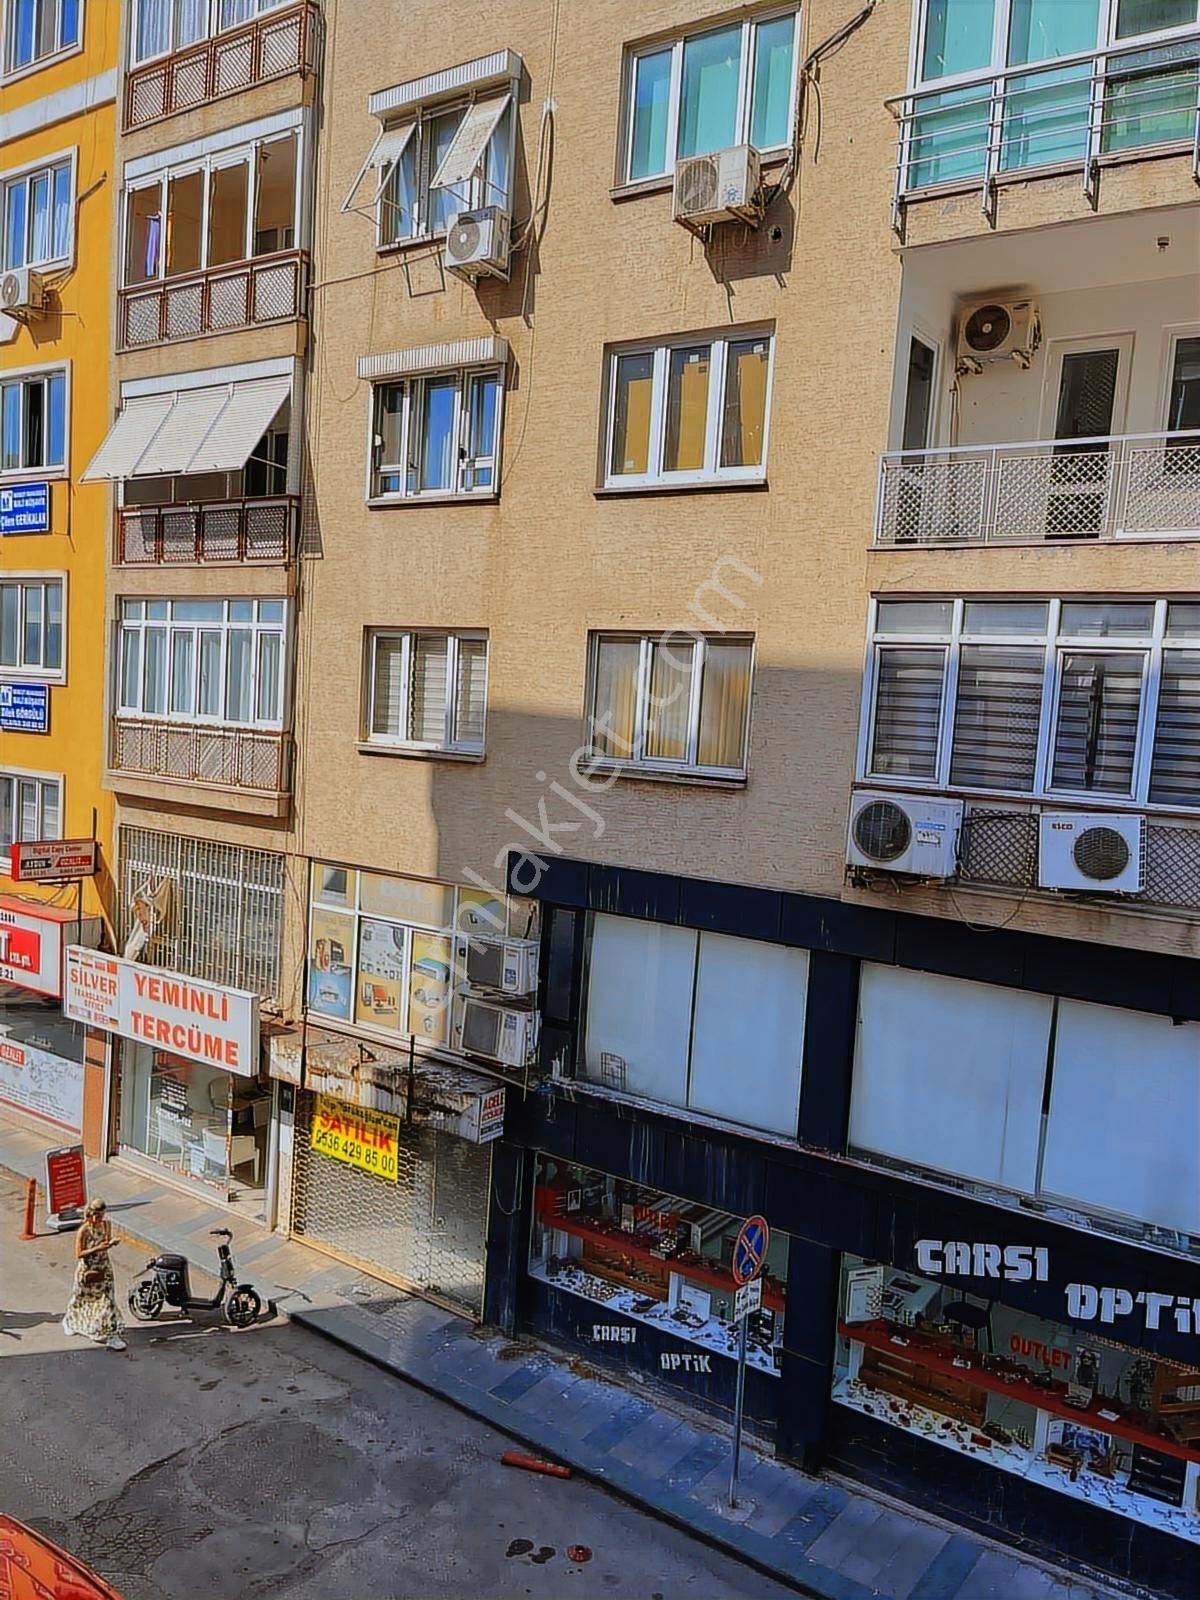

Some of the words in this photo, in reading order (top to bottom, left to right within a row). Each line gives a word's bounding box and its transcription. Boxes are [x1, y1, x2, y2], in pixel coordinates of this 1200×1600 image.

[133, 972, 229, 1022] YEMİNLİ
[131, 1010, 239, 1066] TERCÜME
[319, 1110, 394, 1153] SATILIK
[342, 1139, 362, 1161] 429
[365, 1148, 378, 1167] 85
[381, 1155, 395, 1174] 00
[1009, 1332, 1072, 1370] OUTLET
